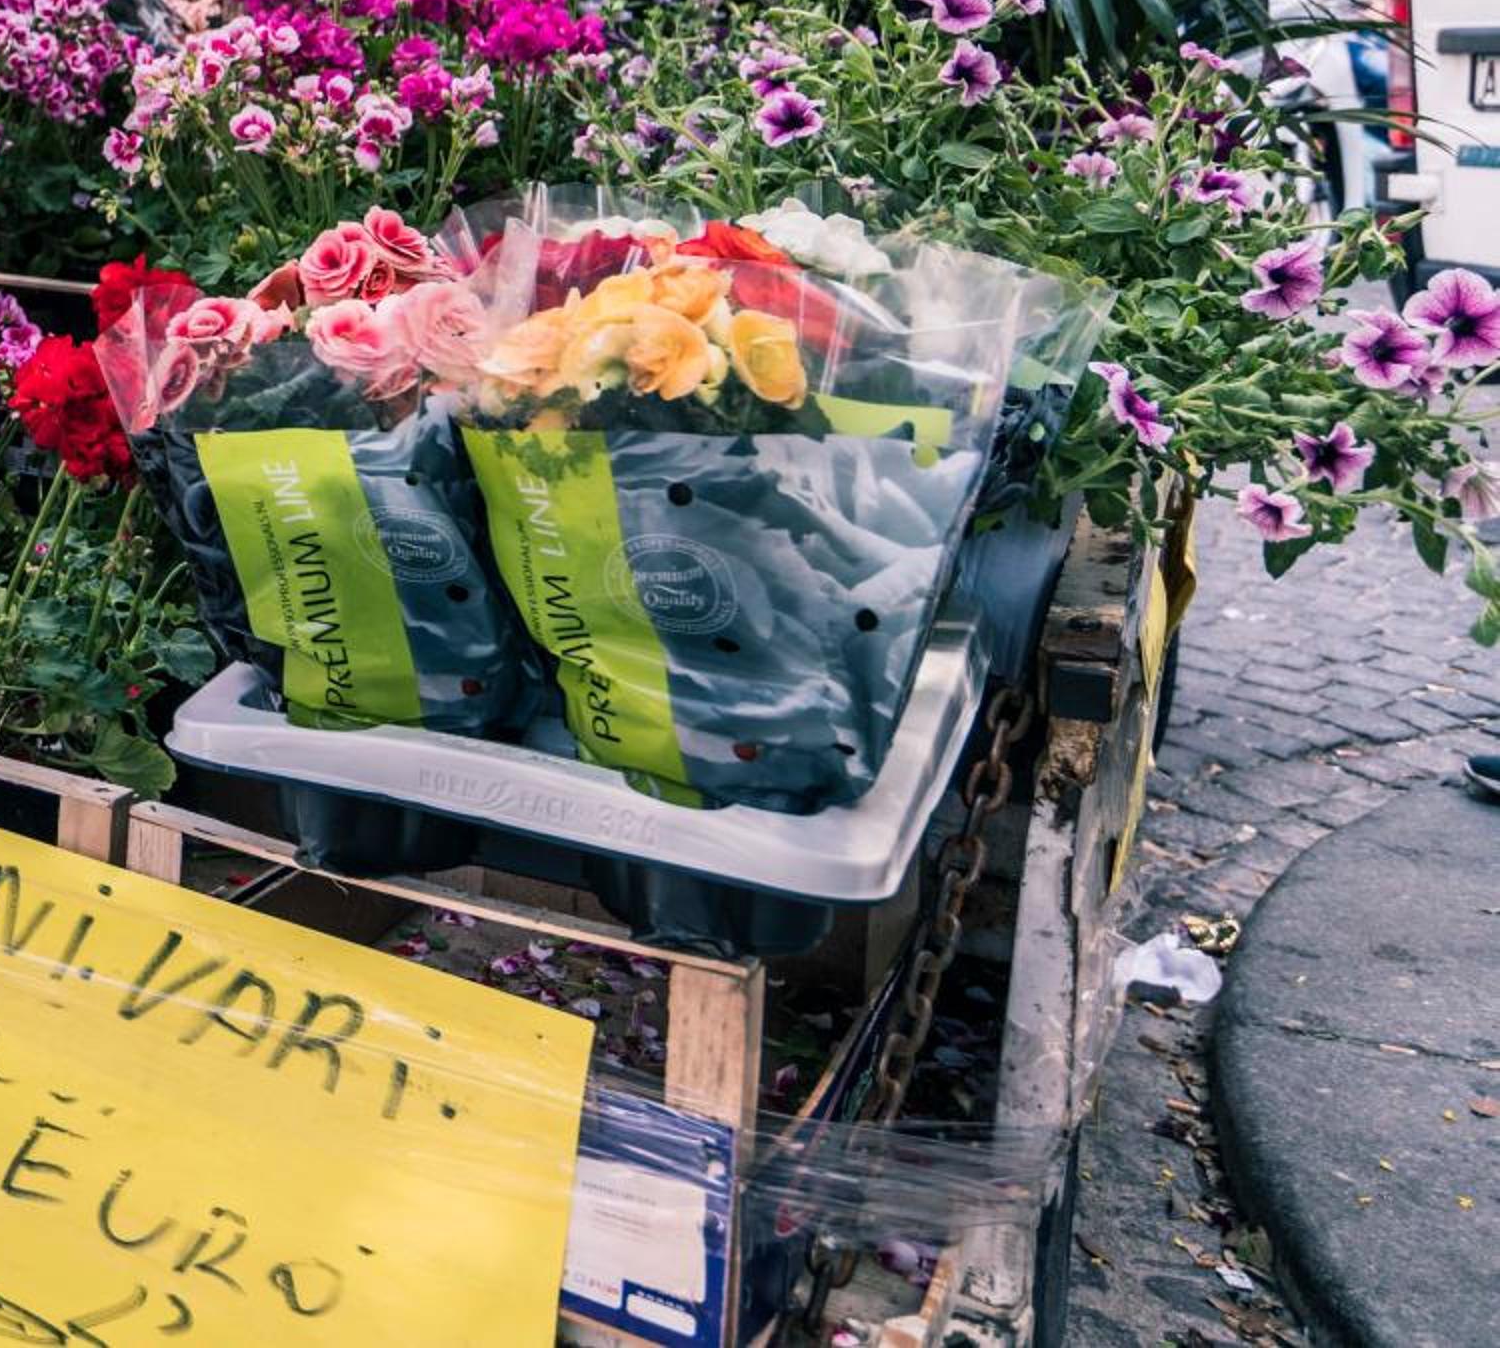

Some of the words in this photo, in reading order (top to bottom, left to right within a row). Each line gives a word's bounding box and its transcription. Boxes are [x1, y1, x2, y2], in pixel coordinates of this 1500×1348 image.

[261, 459, 315, 524] LINE
[516, 475, 567, 558] LINE
[289, 531, 357, 709] PREMIUM
[542, 574, 621, 743] PREMIUM
